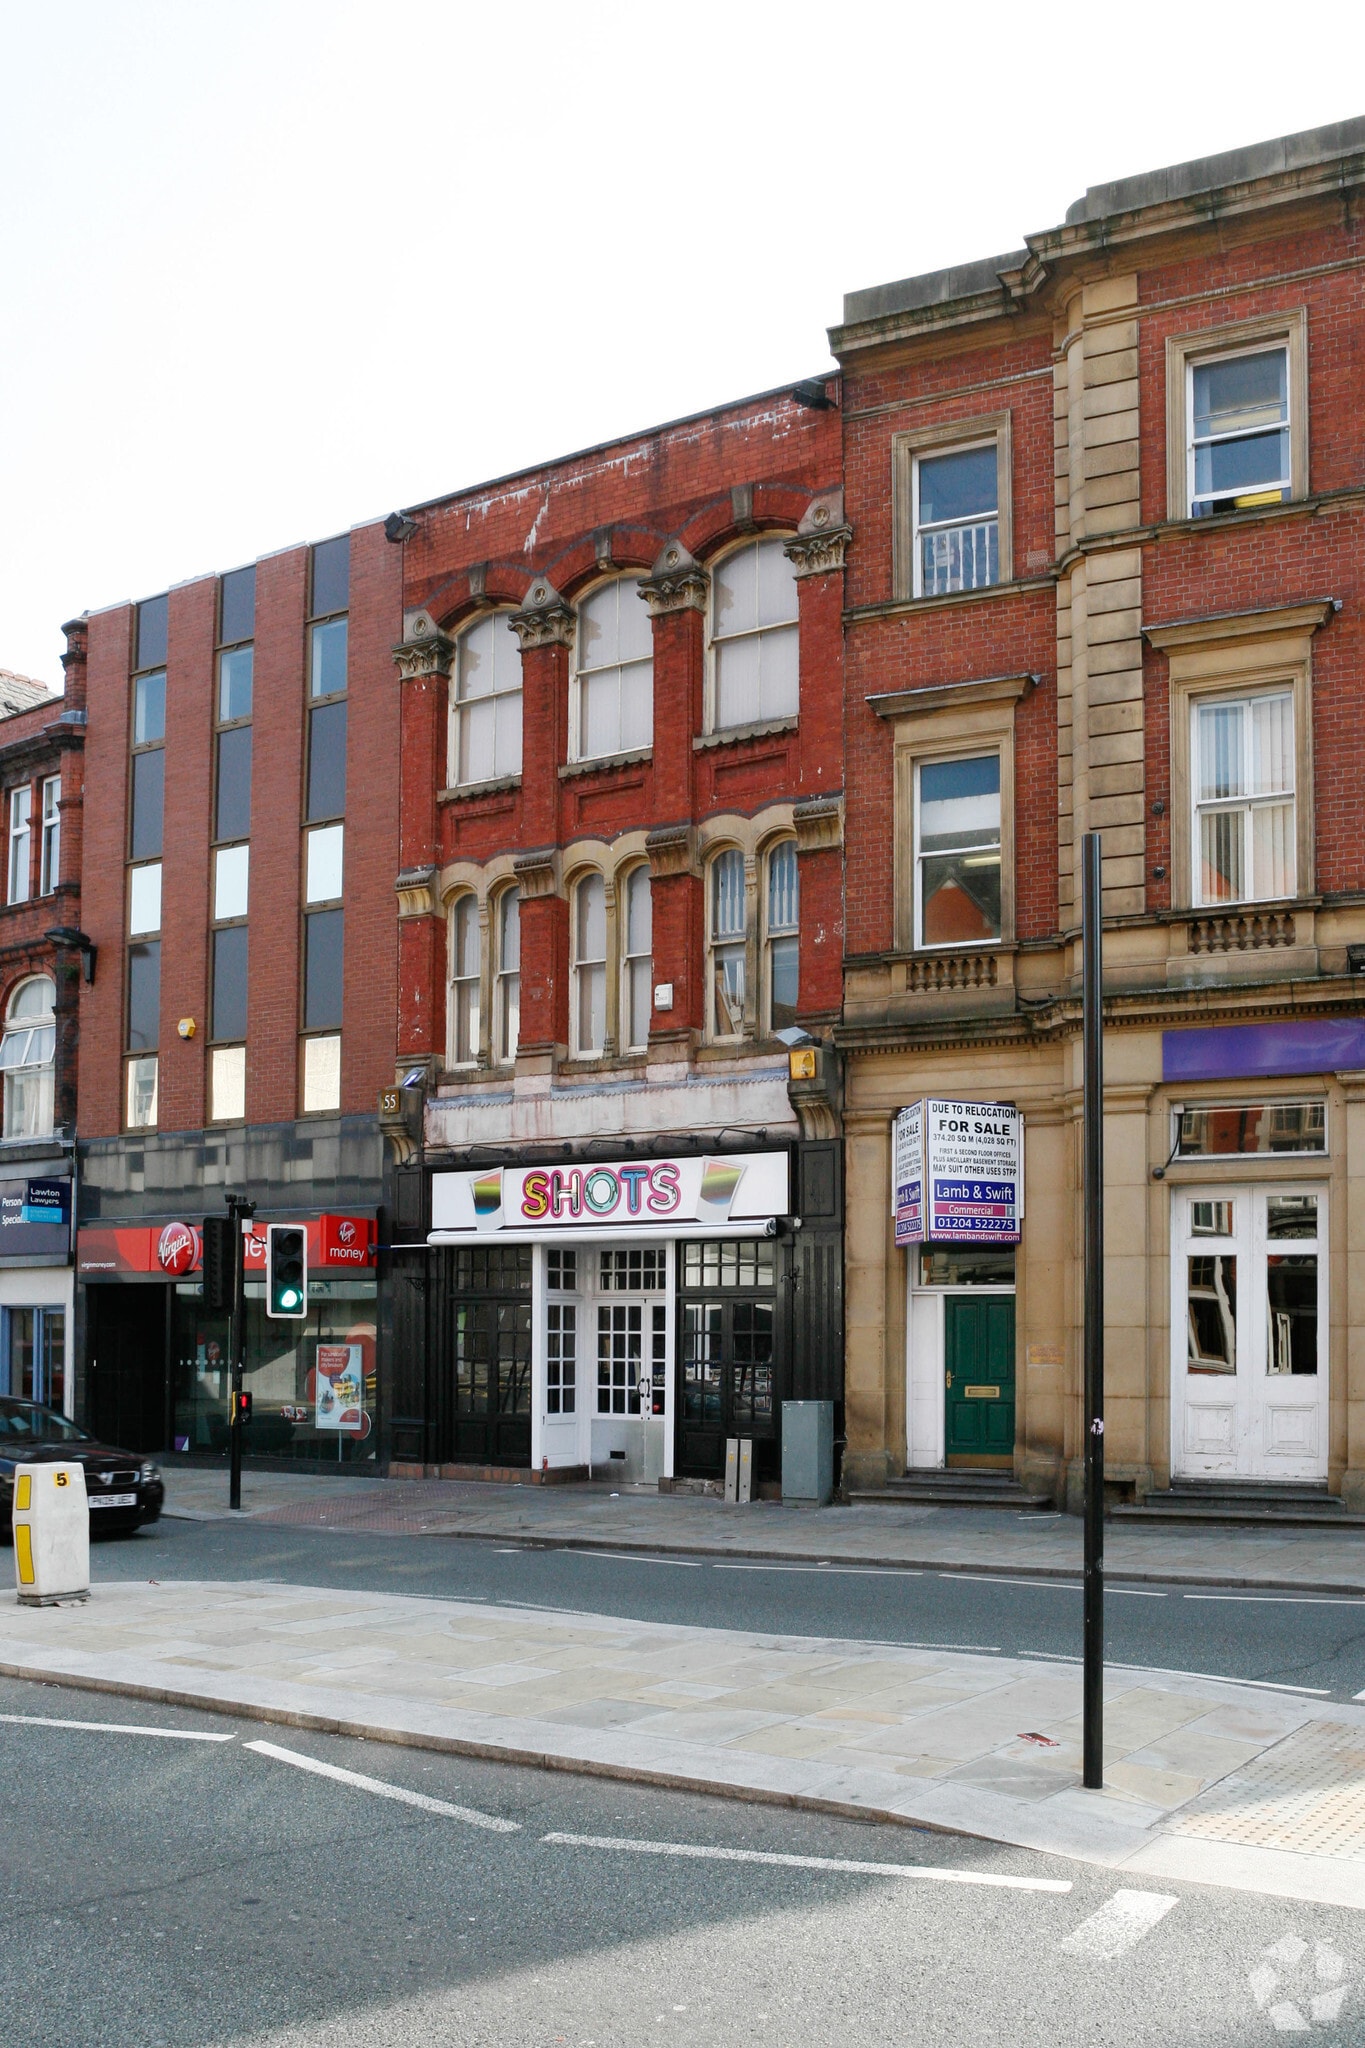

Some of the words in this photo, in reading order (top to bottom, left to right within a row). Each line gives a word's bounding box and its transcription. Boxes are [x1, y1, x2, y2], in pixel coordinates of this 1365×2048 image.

[384, 1094, 396, 1108] 55
[932, 1104, 949, 1113] DUE
[952, 1105, 962, 1114] TO
[965, 1106, 1016, 1118] RELOCATION
[906, 1122, 918, 1137] SALE
[939, 1120, 969, 1132] FOR
[974, 1122, 1010, 1135] SALE
[975, 1136, 995, 1145] (4,028
[1006, 1139, 1016, 1147] FT)
[933, 1164, 946, 1172] MAY
[948, 1165, 962, 1173] SUIT
[965, 1166, 984, 1174] OTHER
[986, 1167, 1001, 1176] USES
[1002, 1168, 1017, 1176] STPP
[31, 1188, 60, 1196] Lawton
[521, 1163, 681, 1220] SHOTS
[937, 1184, 970, 1198] Lamb
[973, 1185, 982, 1199] &
[985, 1186, 1012, 1200] Swift
[949, 1205, 993, 1215] Commercial
[938, 1218, 972, 1228] 01204
[975, 1219, 1013, 1229] 522275
[931, 1232, 1020, 1241] www.lambandswift.com
[158, 1228, 190, 1268] Virgin
[330, 1248, 364, 1262] money
[56, 1473, 67, 1486] 5
